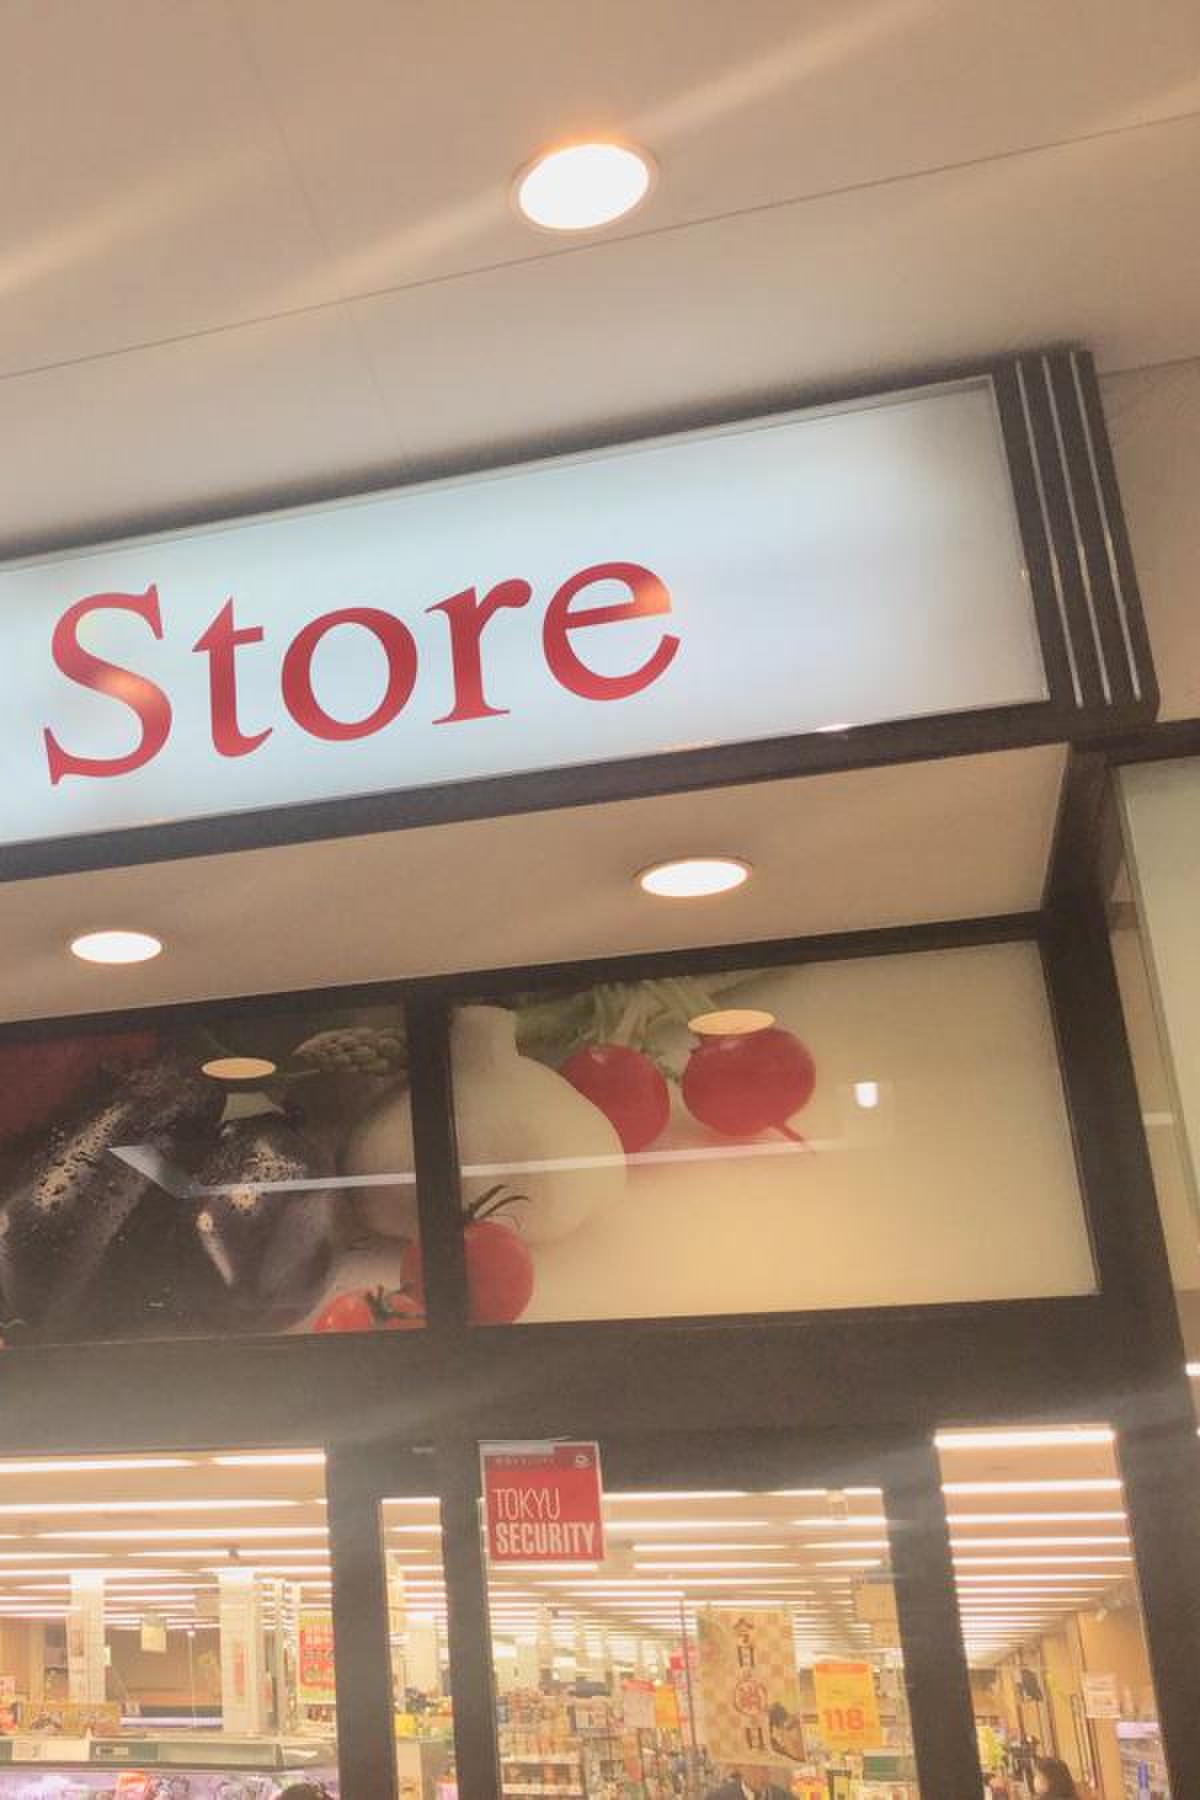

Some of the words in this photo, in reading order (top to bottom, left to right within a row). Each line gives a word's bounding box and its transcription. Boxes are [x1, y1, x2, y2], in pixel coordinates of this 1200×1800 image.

[43, 561, 681, 785] Store
[492, 1487, 561, 1521] TOKYU
[495, 1521, 593, 1555] SECURITY
